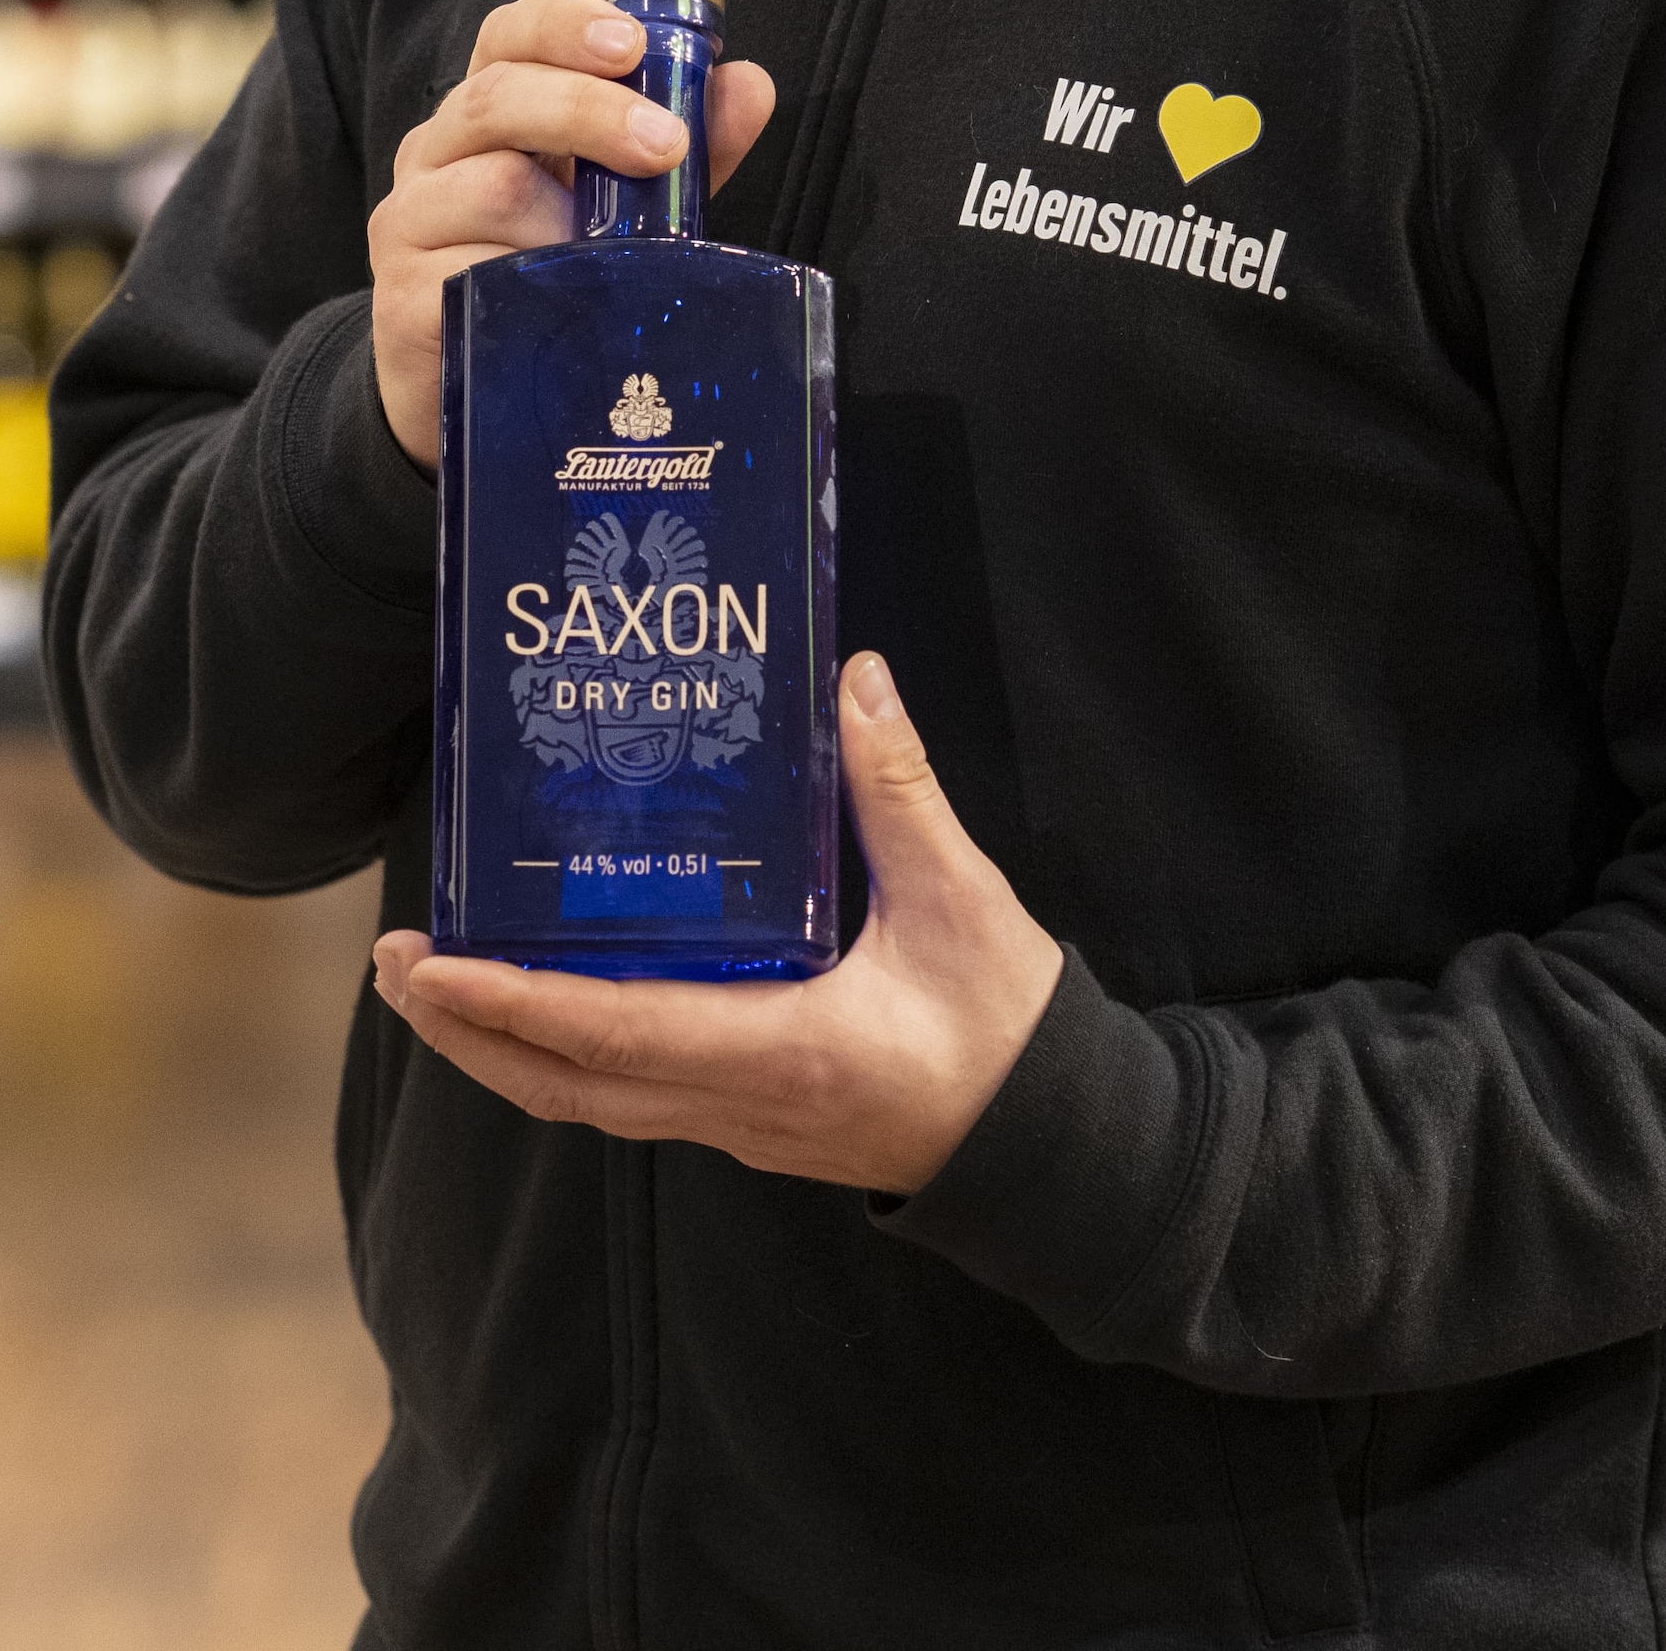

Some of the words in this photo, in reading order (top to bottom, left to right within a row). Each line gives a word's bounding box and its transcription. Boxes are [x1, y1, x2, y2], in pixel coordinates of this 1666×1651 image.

[1043, 77, 1135, 153] Wir
[958, 162, 1287, 300] Lebensmittel.
[558, 482, 643, 491] MANUFAKTUR
[661, 482, 684, 491] SEIT
[688, 482, 710, 490] 1734
[505, 582, 767, 656] SAXON
[555, 681, 631, 711] DRY
[651, 680, 718, 711] GIN
[622, 854, 650, 875] vol
